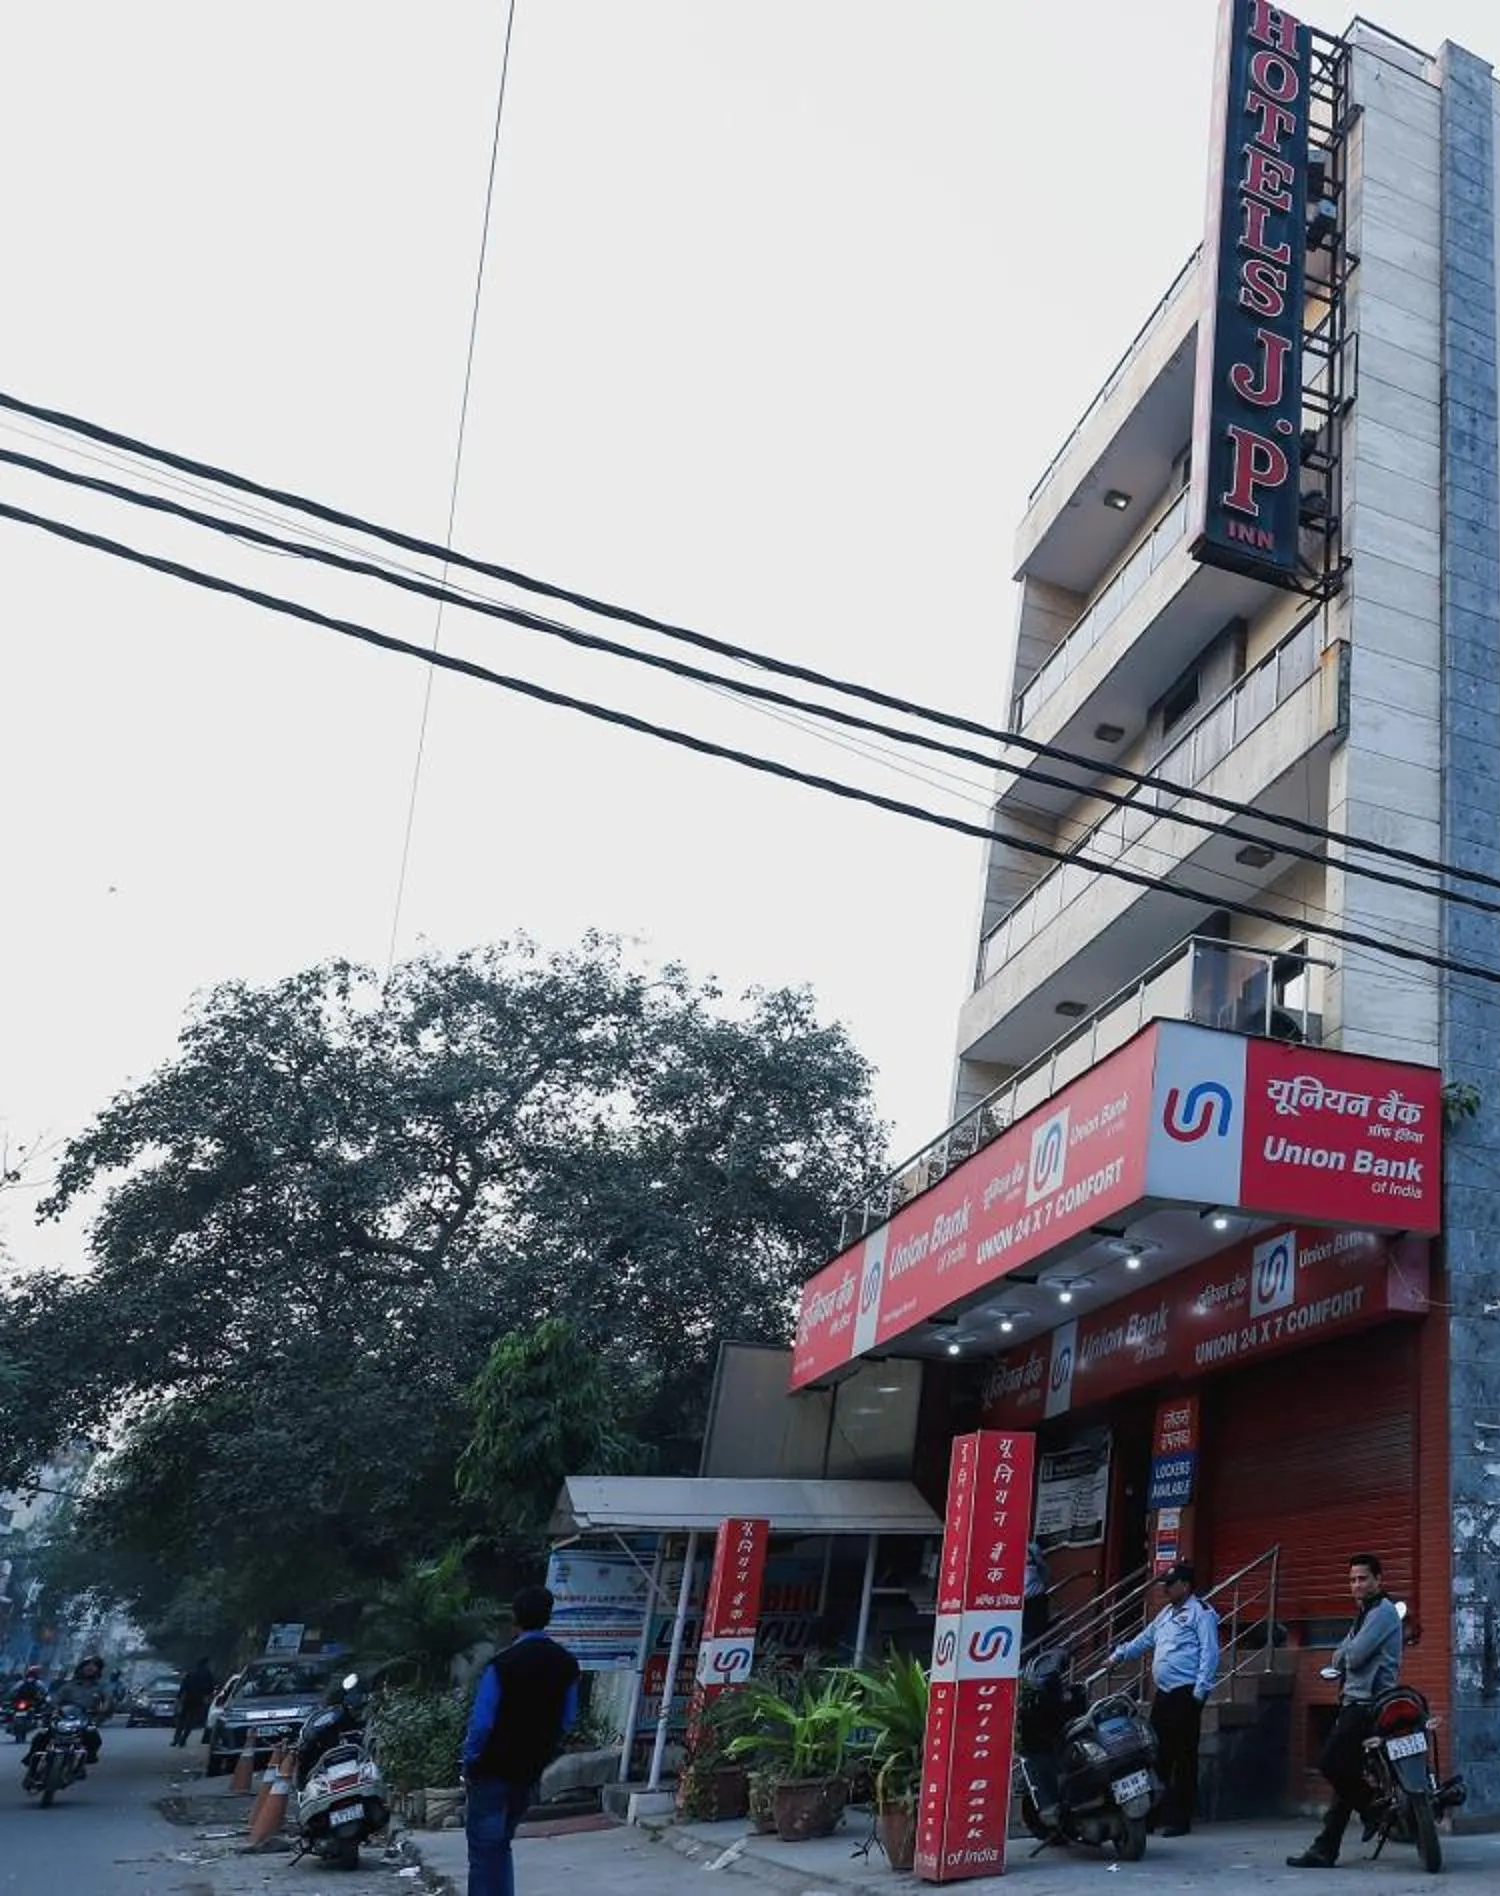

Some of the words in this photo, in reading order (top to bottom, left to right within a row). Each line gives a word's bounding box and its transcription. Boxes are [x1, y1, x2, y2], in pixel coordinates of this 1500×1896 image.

[1238, 0, 1300, 318] HOTELS
[1227, 520, 1275, 550] INN
[1266, 1075, 1375, 1117] यूनियन
[1378, 1090, 1424, 1125] बैंक
[1264, 1135, 1346, 1171] Union
[1352, 1149, 1423, 1182] Bank
[976, 1225, 1014, 1265] UNION
[1014, 1212, 1031, 1243] 24
[1032, 1207, 1043, 1233] X
[1045, 1201, 1054, 1226] 7
[1054, 1156, 1125, 1219] COMFORT
[1371, 1181, 1387, 1193] of
[1389, 1182, 1424, 1198] India
[890, 1231, 929, 1280] Union
[930, 1197, 972, 1253] Bank
[1080, 1324, 1123, 1364] Union
[1125, 1301, 1169, 1345] Bank
[1195, 1331, 1237, 1364] UNION
[1240, 1326, 1256, 1347] 24
[1259, 1321, 1271, 1343] X
[1275, 1316, 1286, 1336] 7
[1287, 1285, 1365, 1335] COMFORT
[1151, 1480, 1192, 1499] AVAILABLE
[1155, 1460, 1191, 1479] LOCKERS
[972, 1685, 997, 1759] Union
[967, 1779, 988, 1839] Bank
[947, 1850, 963, 1865] of
[964, 1848, 998, 1864] India
